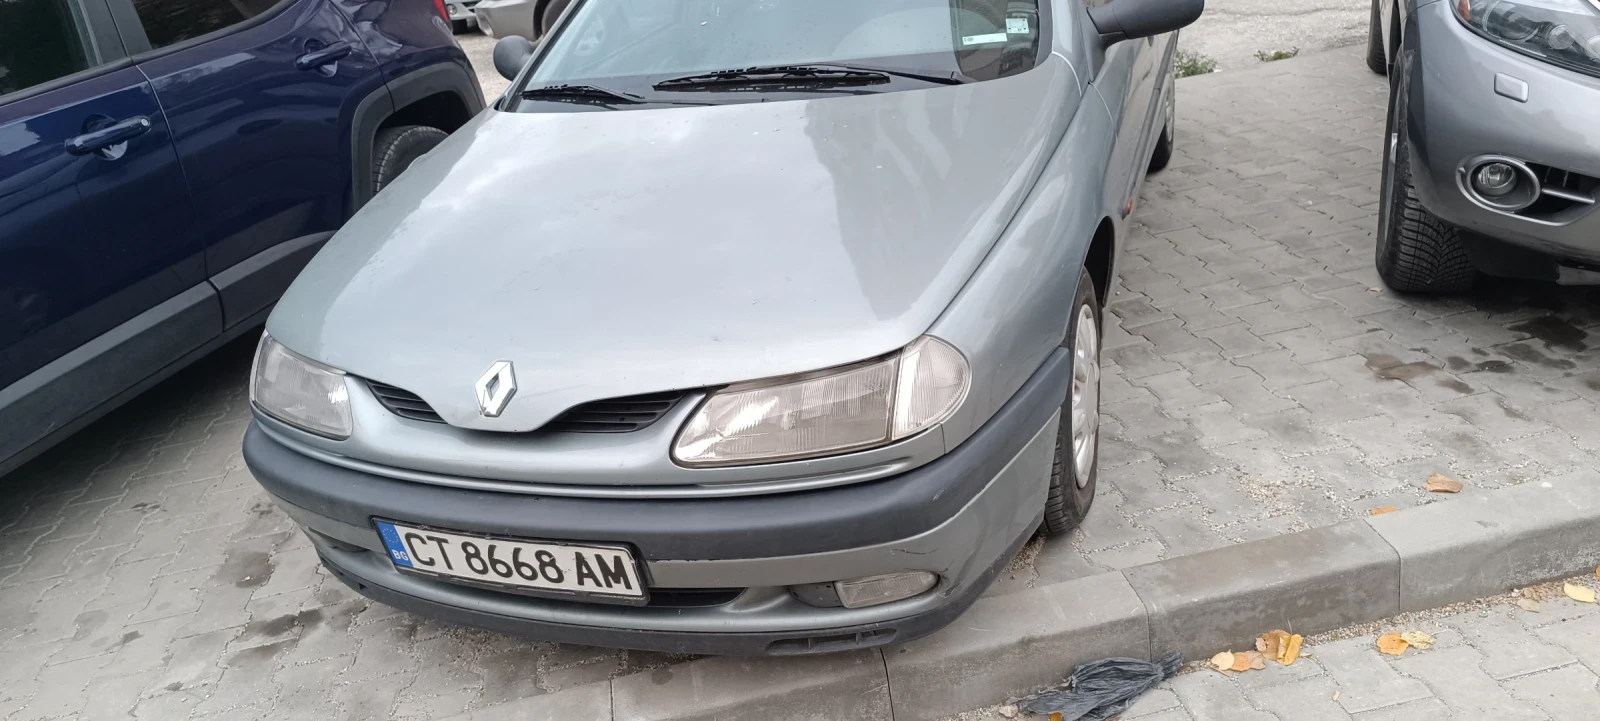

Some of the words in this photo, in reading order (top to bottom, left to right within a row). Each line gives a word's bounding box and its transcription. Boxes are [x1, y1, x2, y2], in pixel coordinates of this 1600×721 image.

[391, 549, 409, 561] BG
[404, 532, 453, 570] CT
[461, 541, 565, 583] 8668
[575, 551, 633, 590] AM
